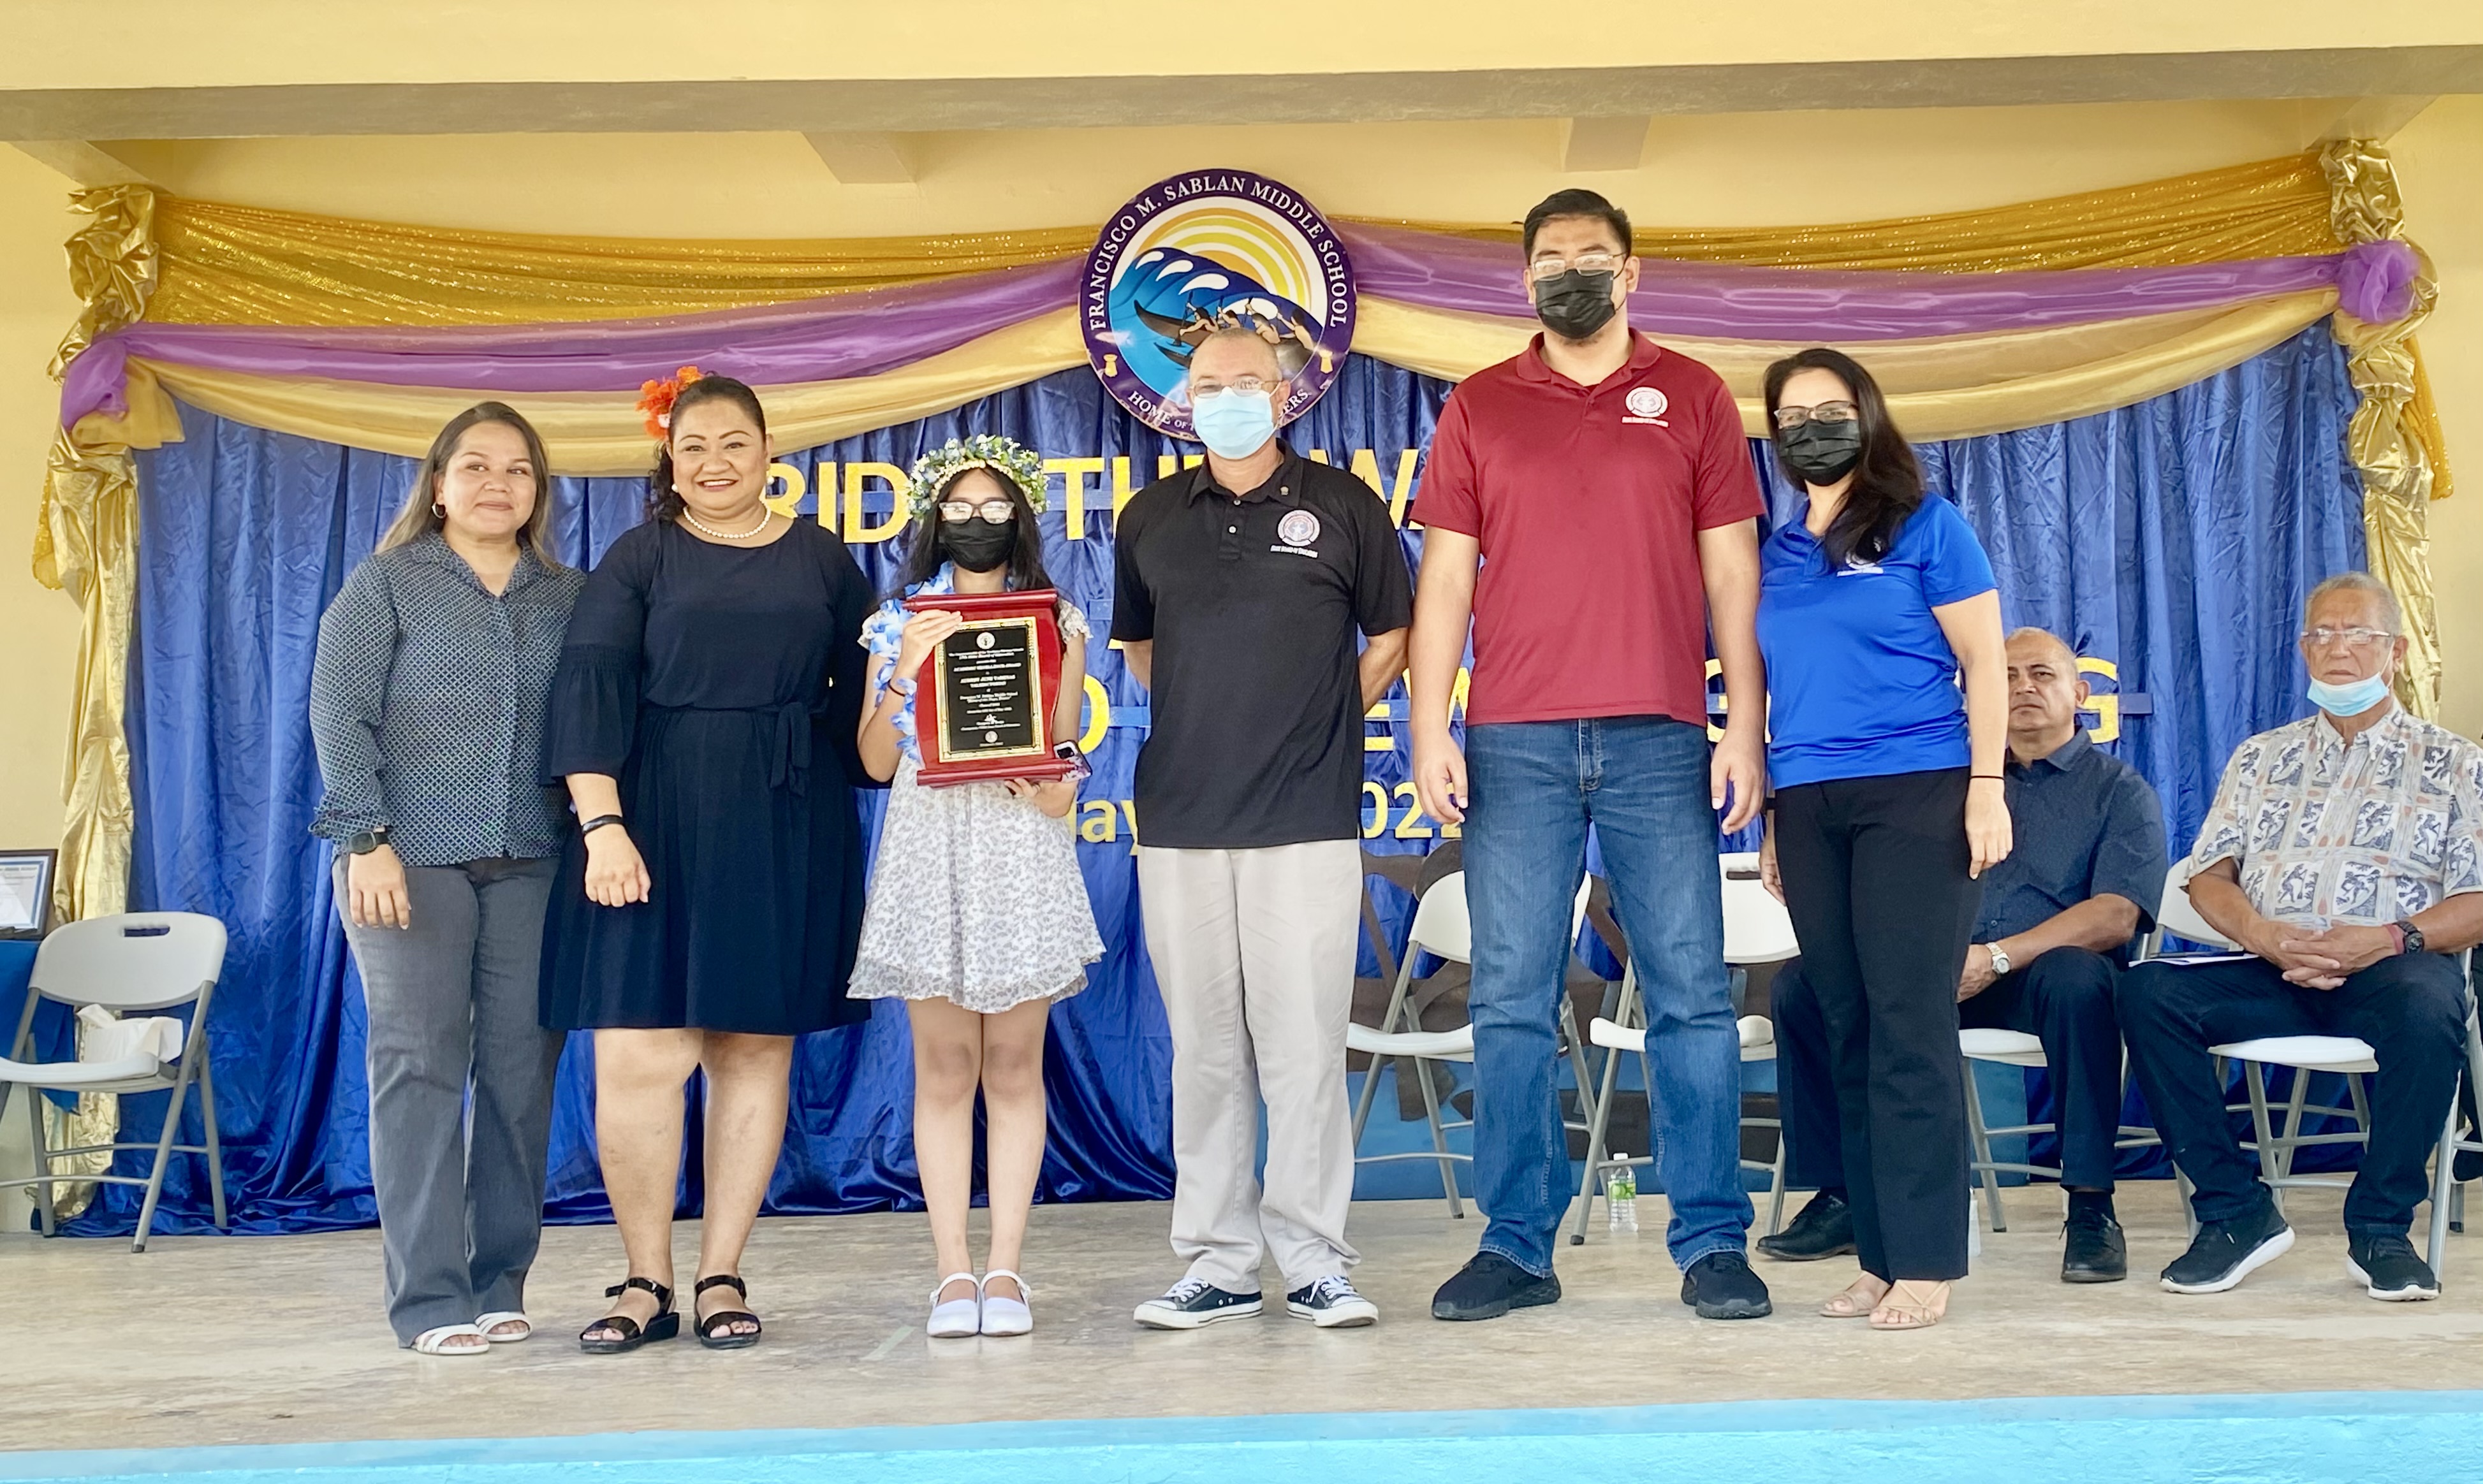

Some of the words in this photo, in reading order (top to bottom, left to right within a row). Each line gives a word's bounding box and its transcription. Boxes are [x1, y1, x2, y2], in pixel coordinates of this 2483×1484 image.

[1088, 215, 1136, 331] FRANCISCO
[1134, 196, 1162, 218] M.
[1164, 175, 1246, 201] SABLAN
[1250, 181, 1324, 239] MIDDLE
[1317, 240, 1348, 328] SCHOOL
[1127, 390, 1173, 425] HOME
[1174, 419, 1188, 429] OF
[759, 462, 913, 544] RID
